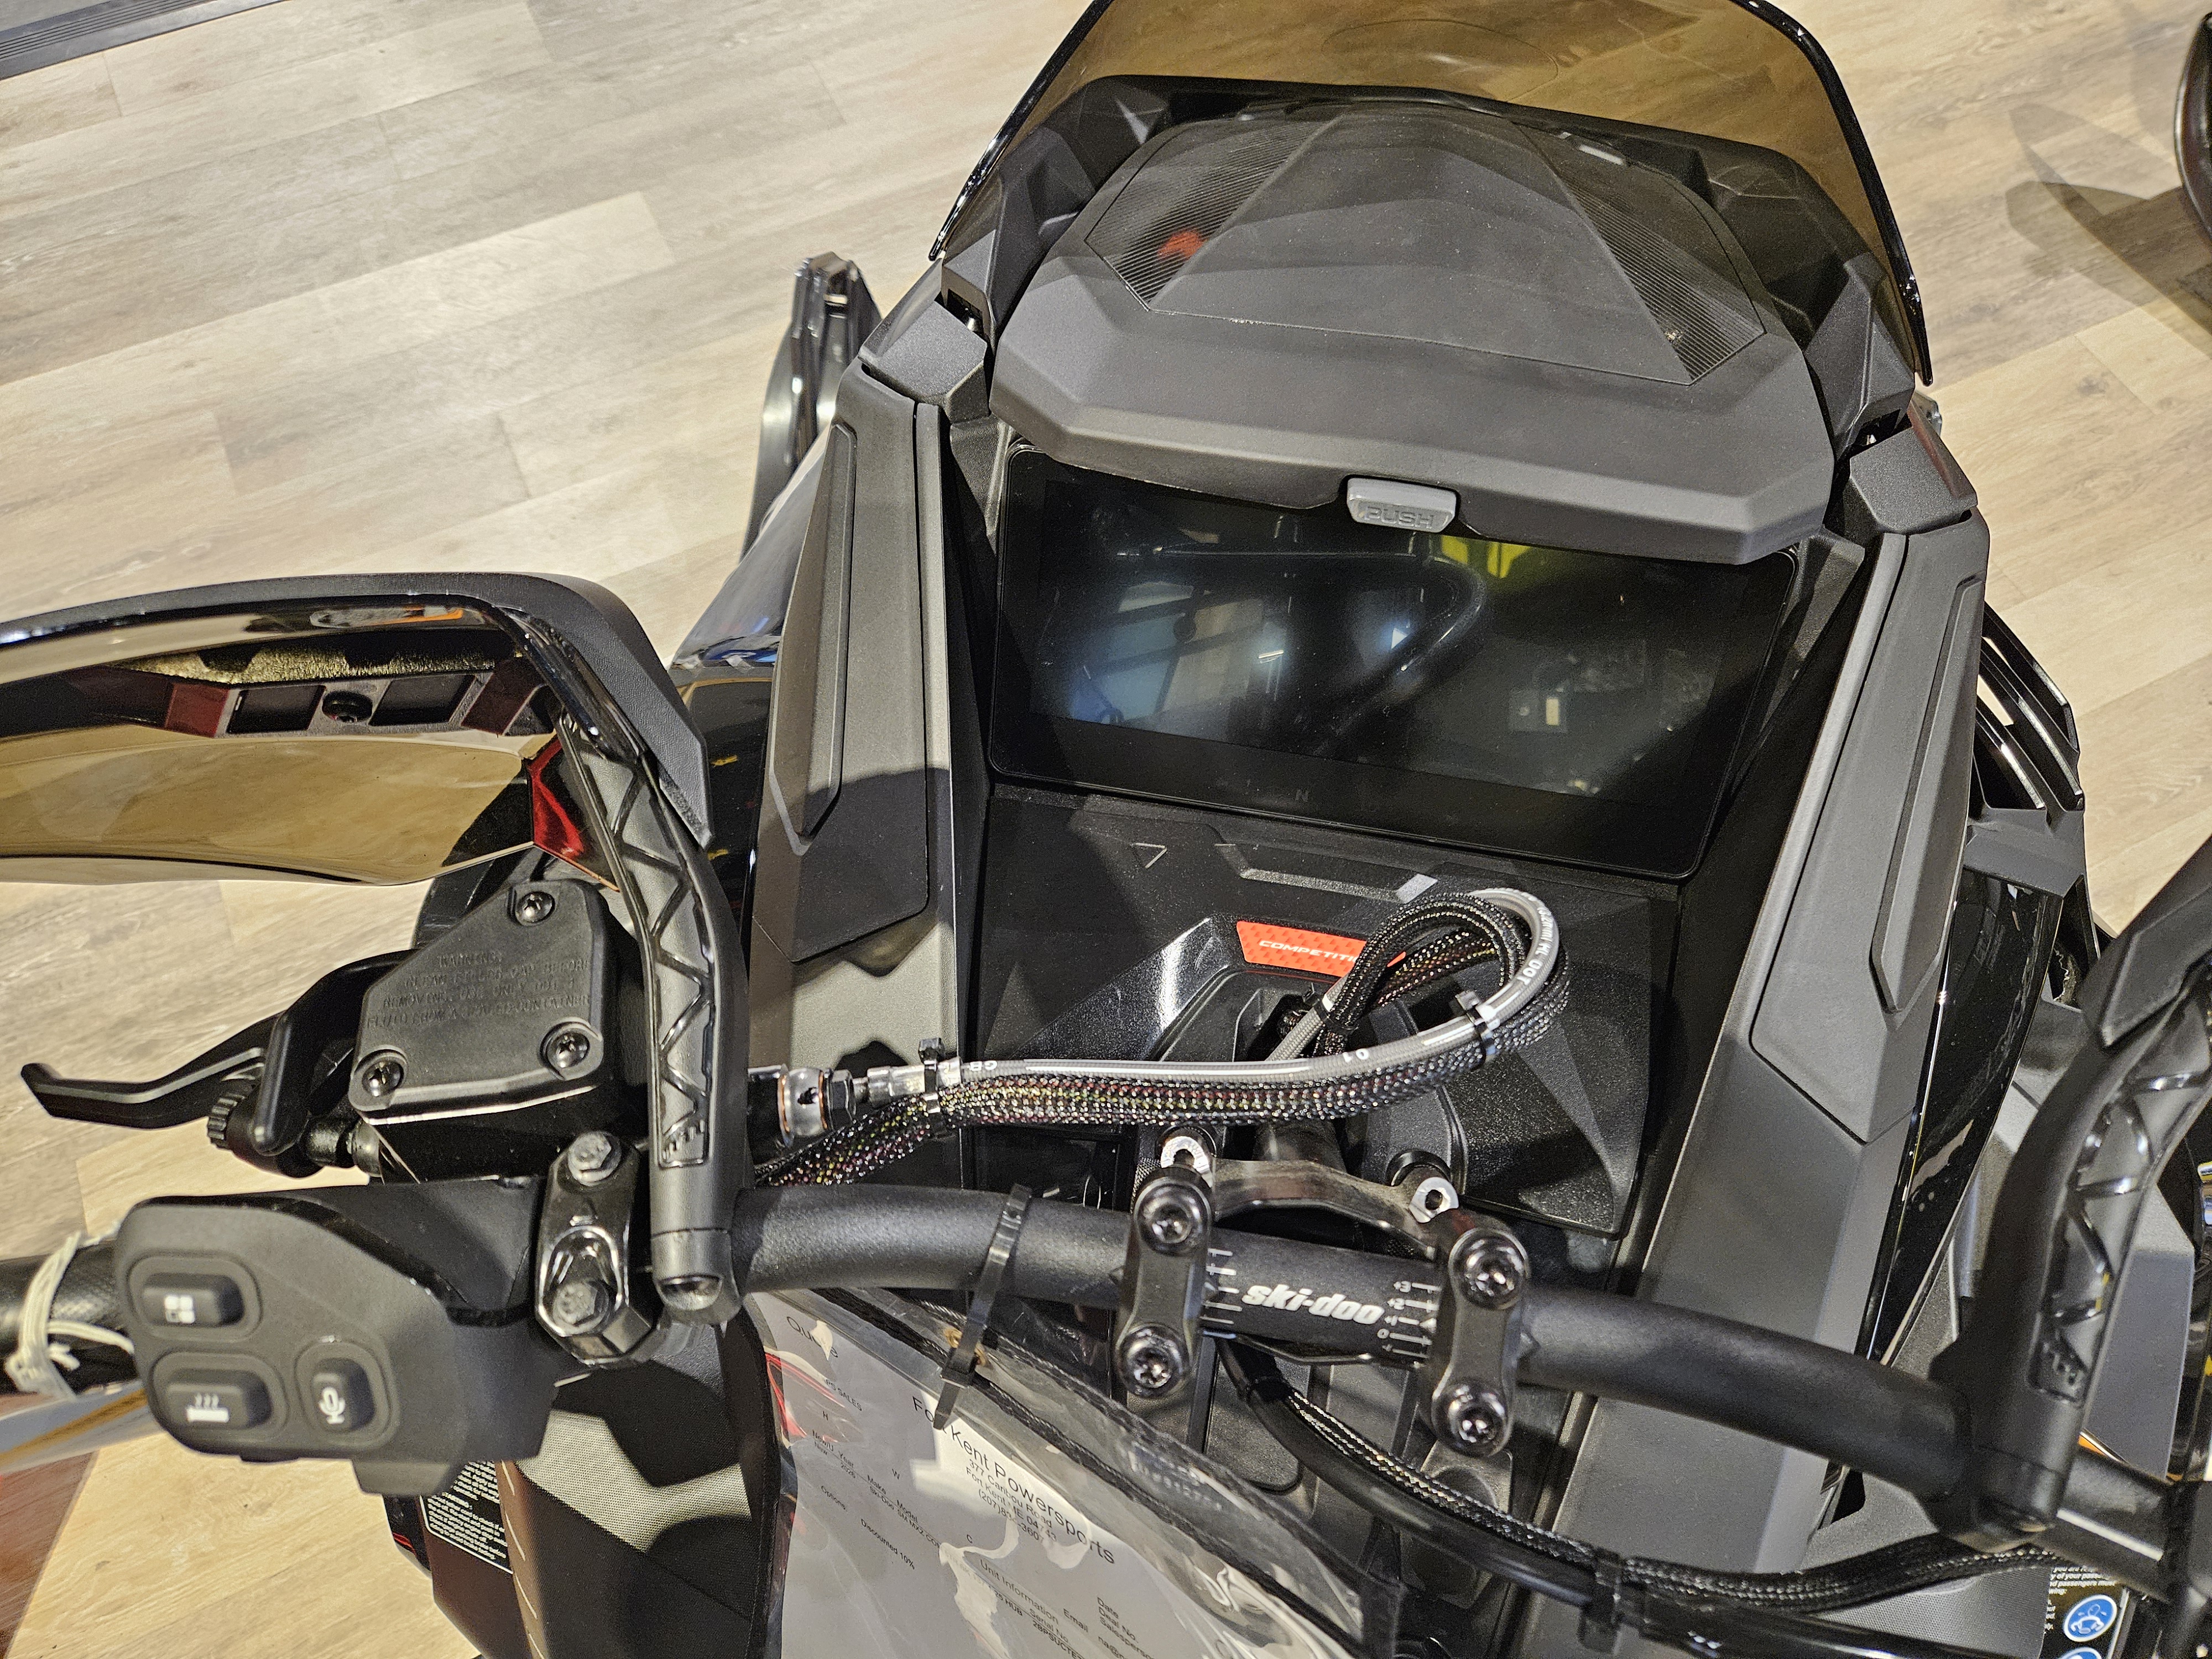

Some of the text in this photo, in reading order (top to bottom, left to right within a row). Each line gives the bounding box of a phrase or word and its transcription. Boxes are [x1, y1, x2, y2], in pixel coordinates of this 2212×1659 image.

[1364, 507, 1433, 529] PUSH
[1259, 940, 1358, 963] COMPETITI
[1516, 959, 1542, 985] DOT
[1241, 1284, 1385, 1324] ski-doo
[786, 1316, 838, 1358] Que
[837, 1388, 862, 1411] SALES
[822, 1411, 828, 1421] H
[891, 1469, 900, 1480] W
[912, 1396, 947, 1434] Fo
[950, 1425, 990, 1470] Kent
[994, 1462, 1115, 1564] Powersports
[838, 1451, 854, 1468] Year
[867, 1475, 886, 1495] Make
[896, 1500, 919, 1523] Model
[869, 1486, 894, 1510] Ski-Doo
[969, 1459, 1052, 1528] 377 Caribou Road
[966, 1467, 985, 1487] Fort
[985, 1485, 1006, 1507] Kent
[1026, 1514, 1057, 1542] 04743
[860, 1518, 898, 1555] Discounted
[900, 1552, 915, 1571] 10%
[967, 1534, 973, 1544] C
[980, 1559, 1000, 1581] Unit
[1002, 1576, 1059, 1625] Information
[1005, 1599, 1023, 1616] HUB
[1097, 1597, 1119, 1619] Date
[1098, 1606, 1120, 1629] Deal
[1029, 1609, 1054, 1632] Serial
[1063, 1608, 1089, 1632] Email
[1032, 1620, 1084, 1659] 2BPSUCTE
